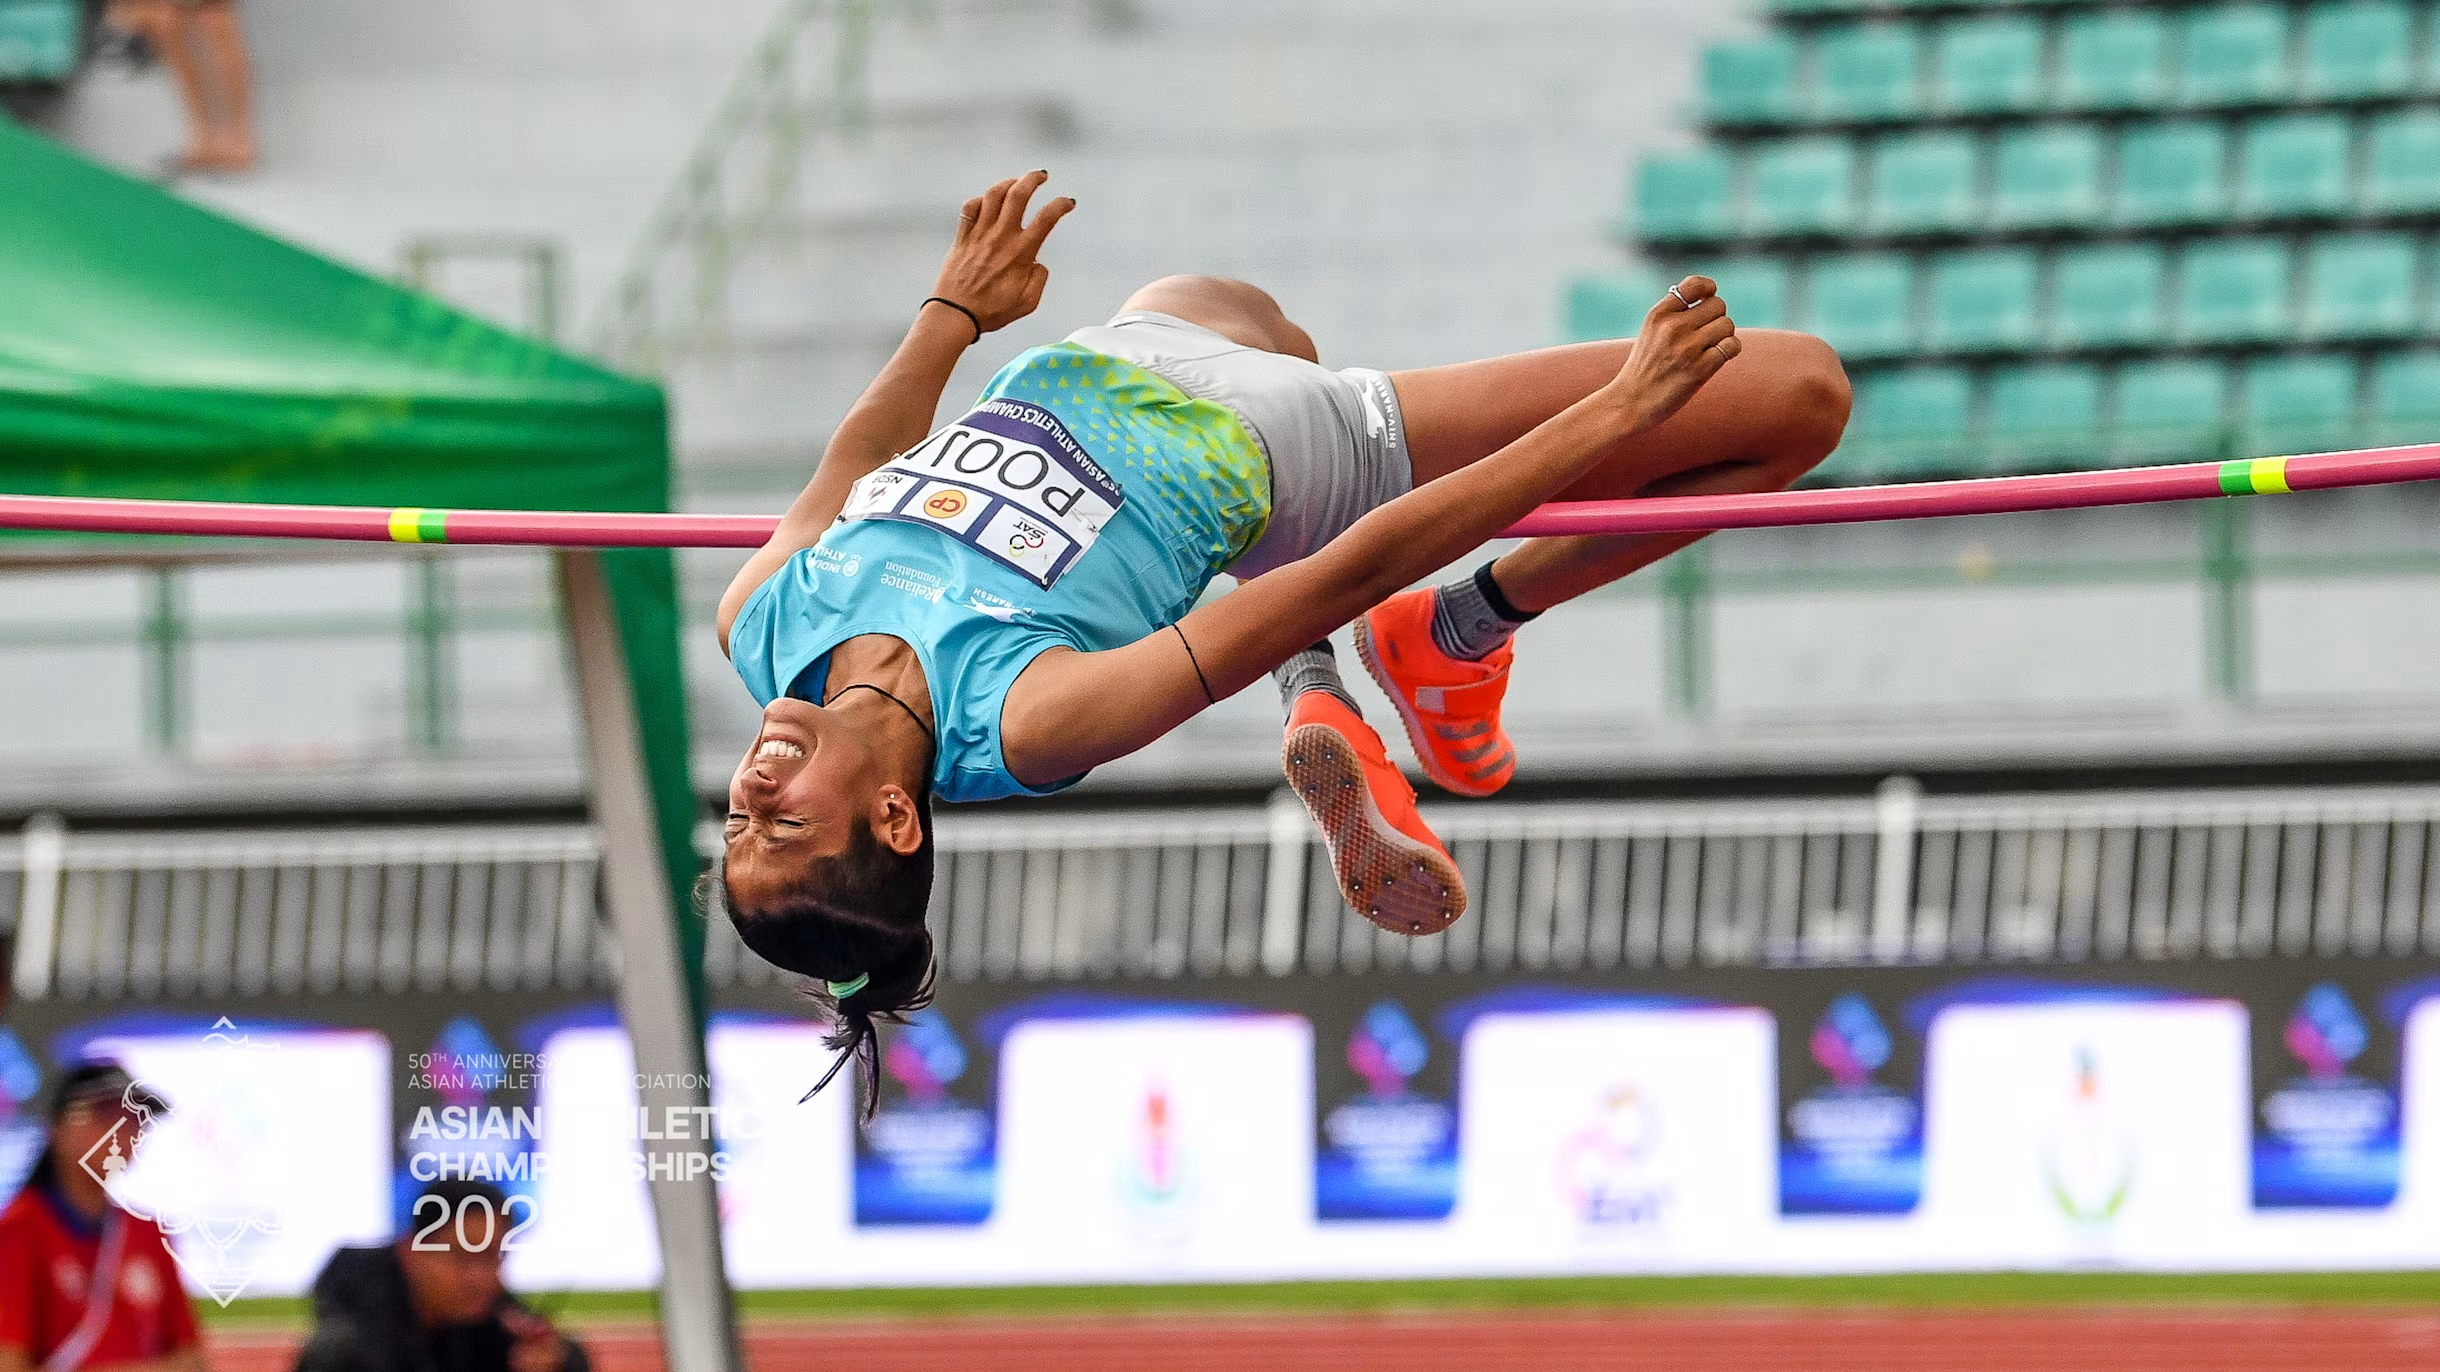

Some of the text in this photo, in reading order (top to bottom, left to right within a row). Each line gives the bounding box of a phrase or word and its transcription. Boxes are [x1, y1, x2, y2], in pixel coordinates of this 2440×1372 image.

[1021, 408, 1076, 452] ATHLETICS
[1073, 449, 1106, 481] ASIAN
[929, 497, 961, 513] CP
[880, 573, 933, 600] Reliance
[885, 561, 942, 586] Foundation
